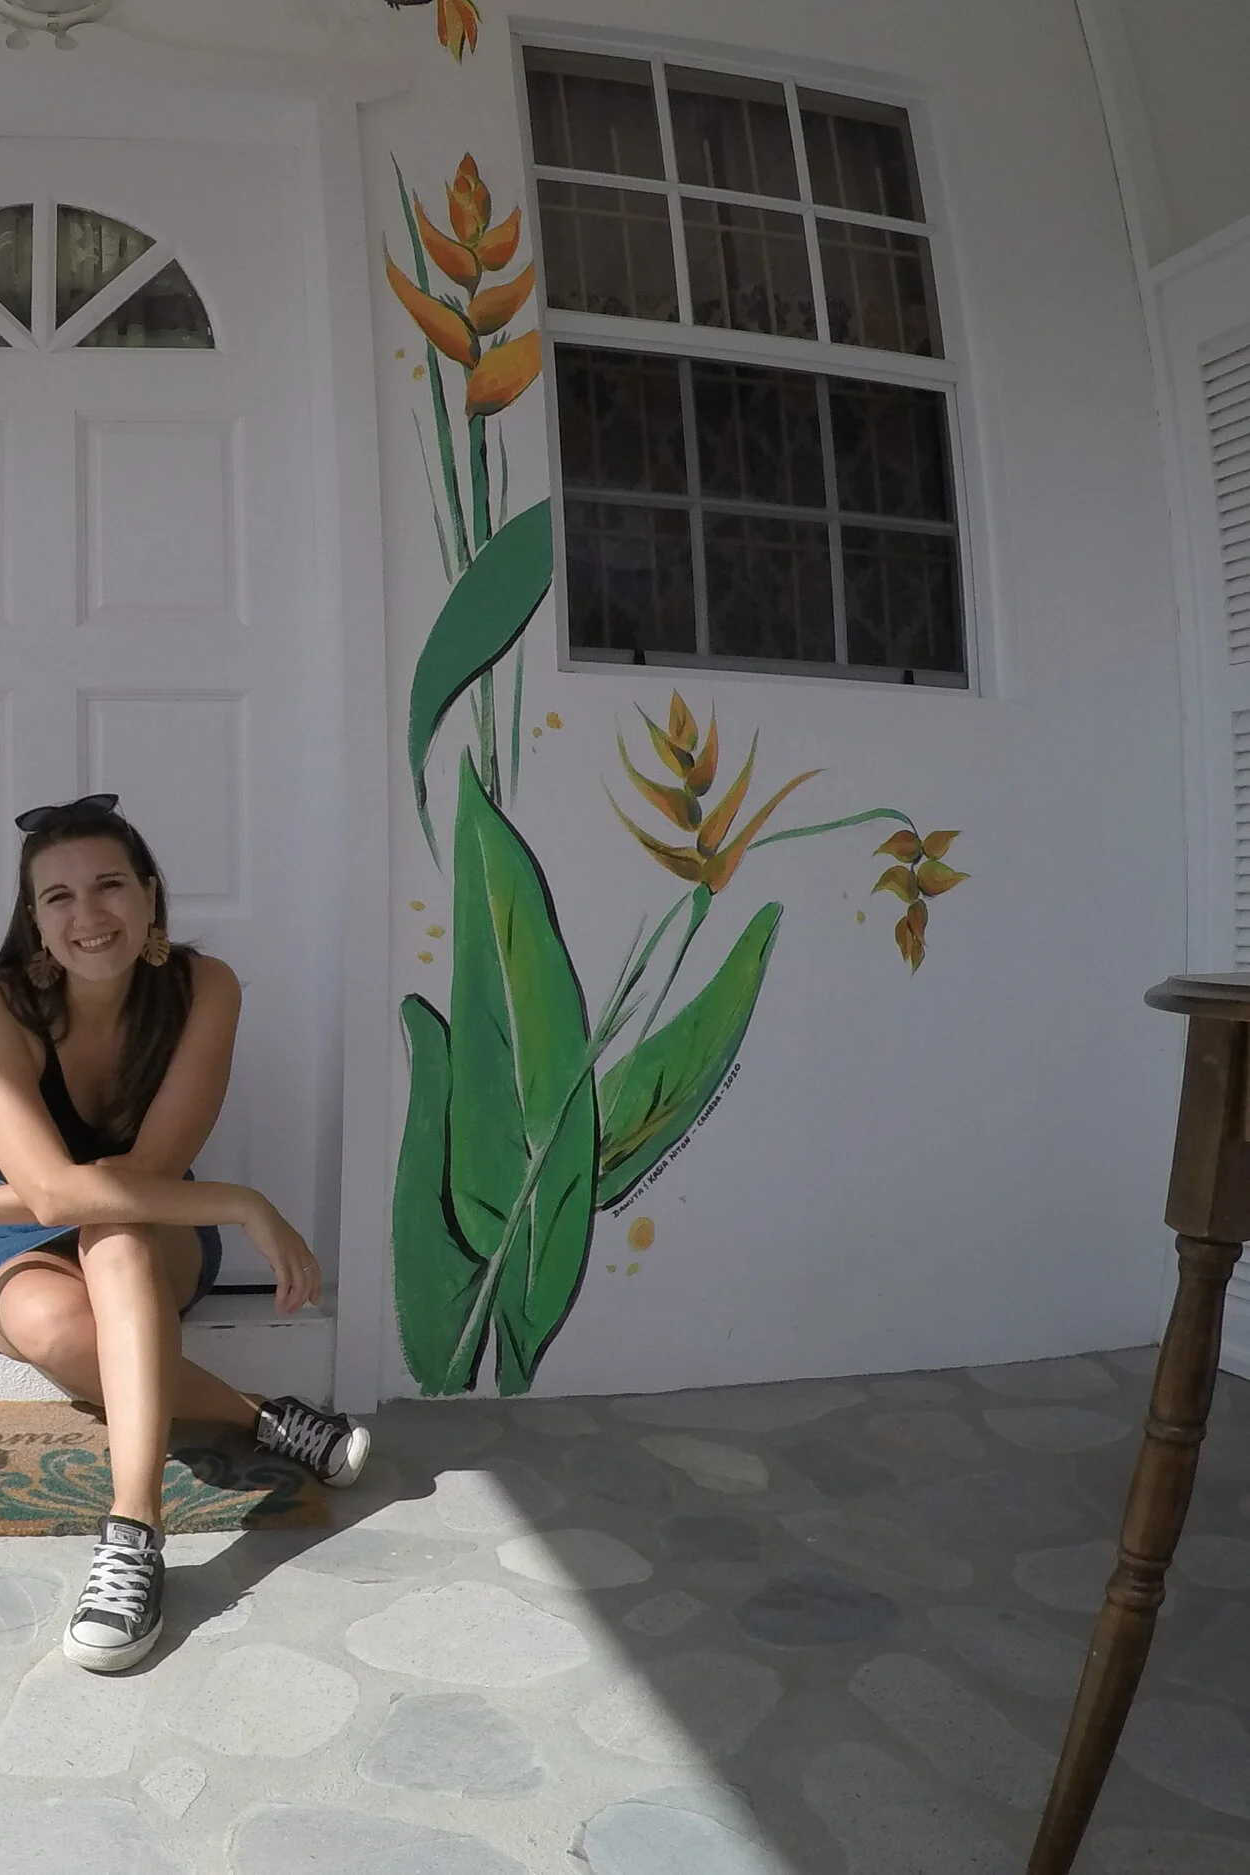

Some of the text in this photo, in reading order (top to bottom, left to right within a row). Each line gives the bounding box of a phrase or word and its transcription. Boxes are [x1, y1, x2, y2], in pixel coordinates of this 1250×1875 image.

[611, 1186, 645, 1219] DANUTA
[647, 1160, 669, 1185] KASIA
[696, 1095, 723, 1127] CANADA
[723, 1062, 742, 1090] 2020
